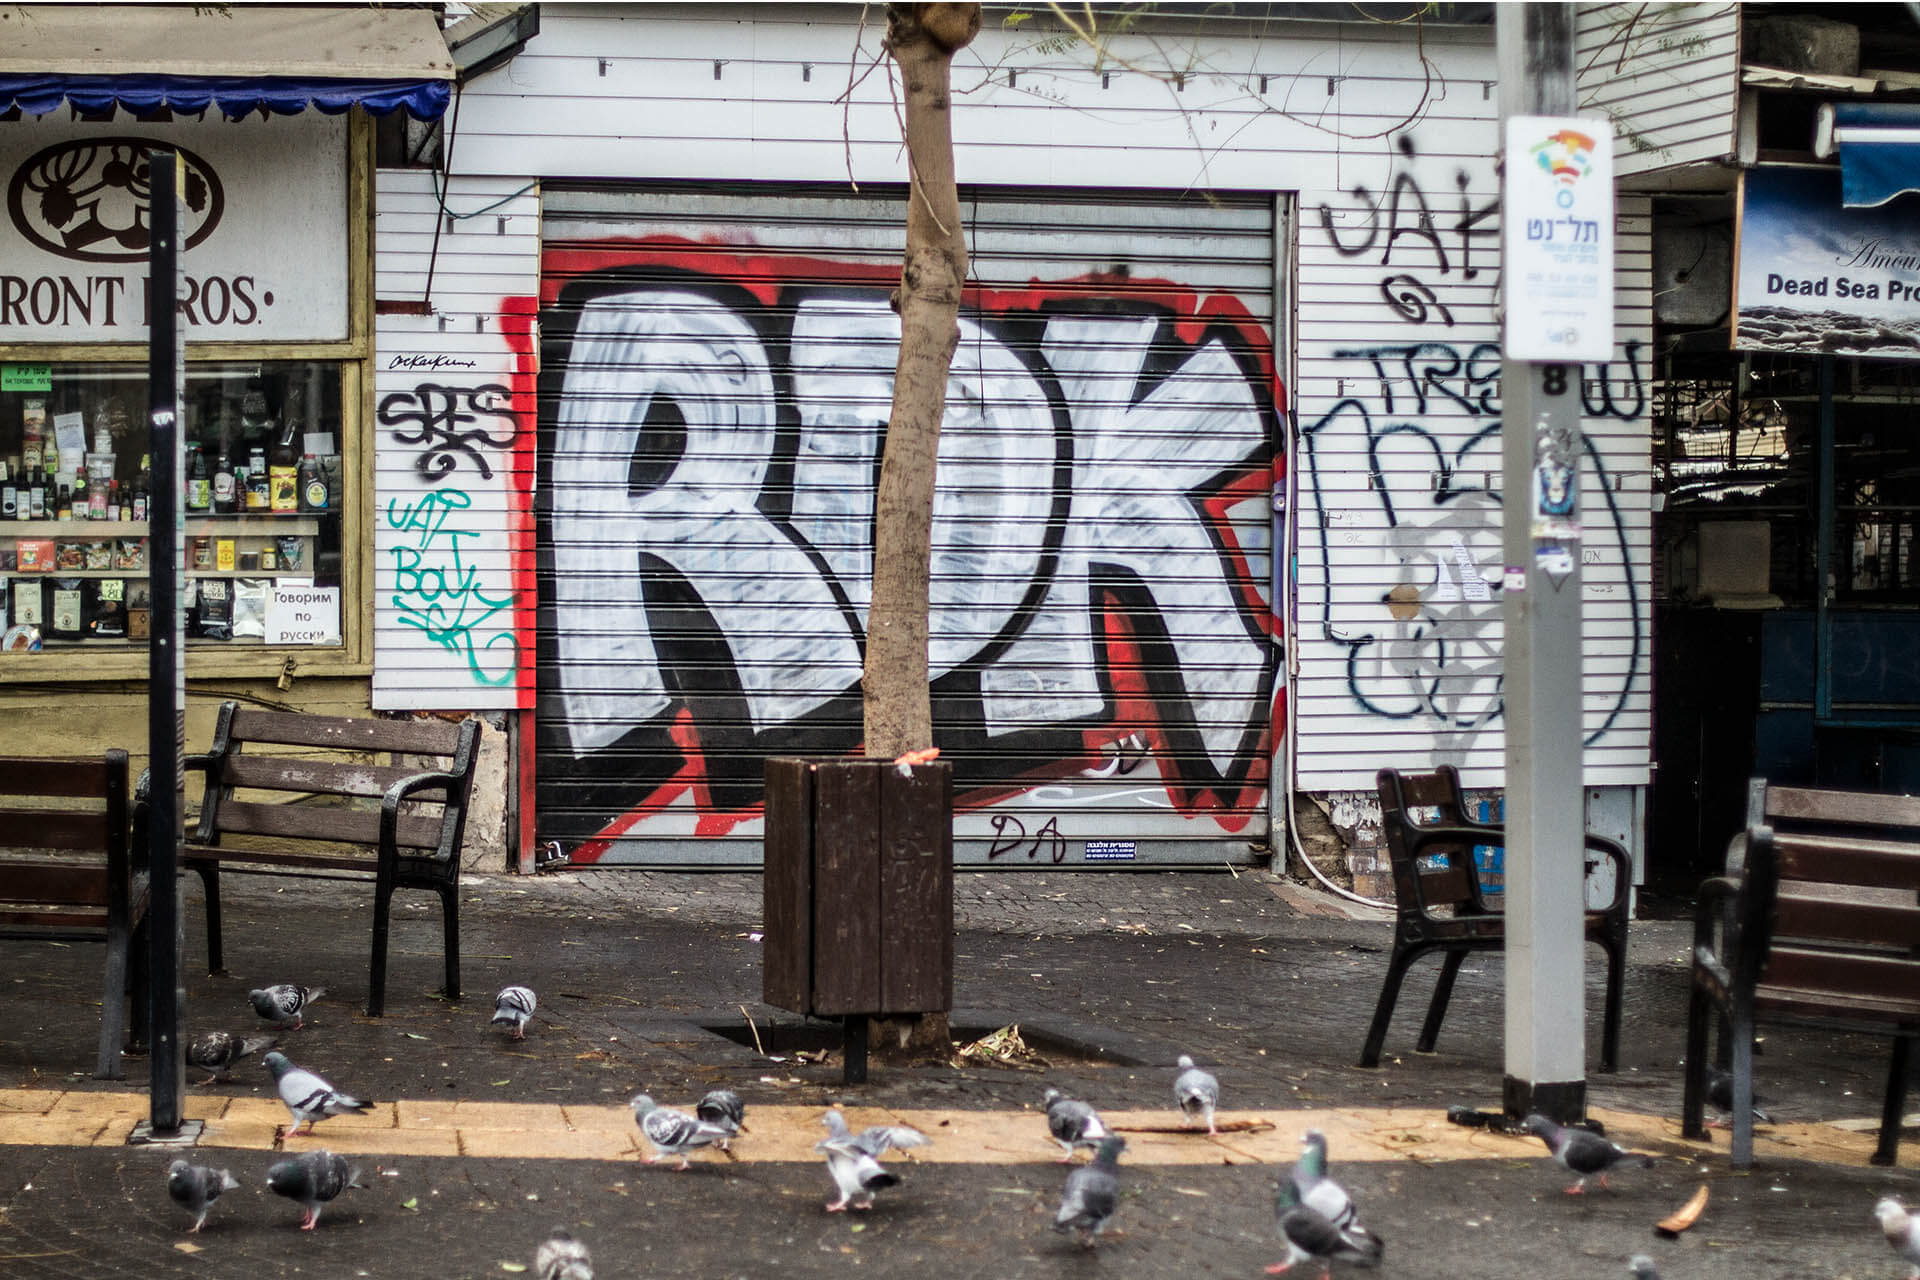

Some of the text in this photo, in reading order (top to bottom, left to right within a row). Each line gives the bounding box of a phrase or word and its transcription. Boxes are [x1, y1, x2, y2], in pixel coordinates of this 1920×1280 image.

[1767, 273, 1829, 297] Dead
[1835, 277, 1880, 299] Sea
[0, 276, 262, 326] RONT ROS.
[1542, 364, 1568, 396] 8
[274, 592, 332, 605] Говорим
[295, 612, 312, 622] по
[280, 631, 325, 641] русски
